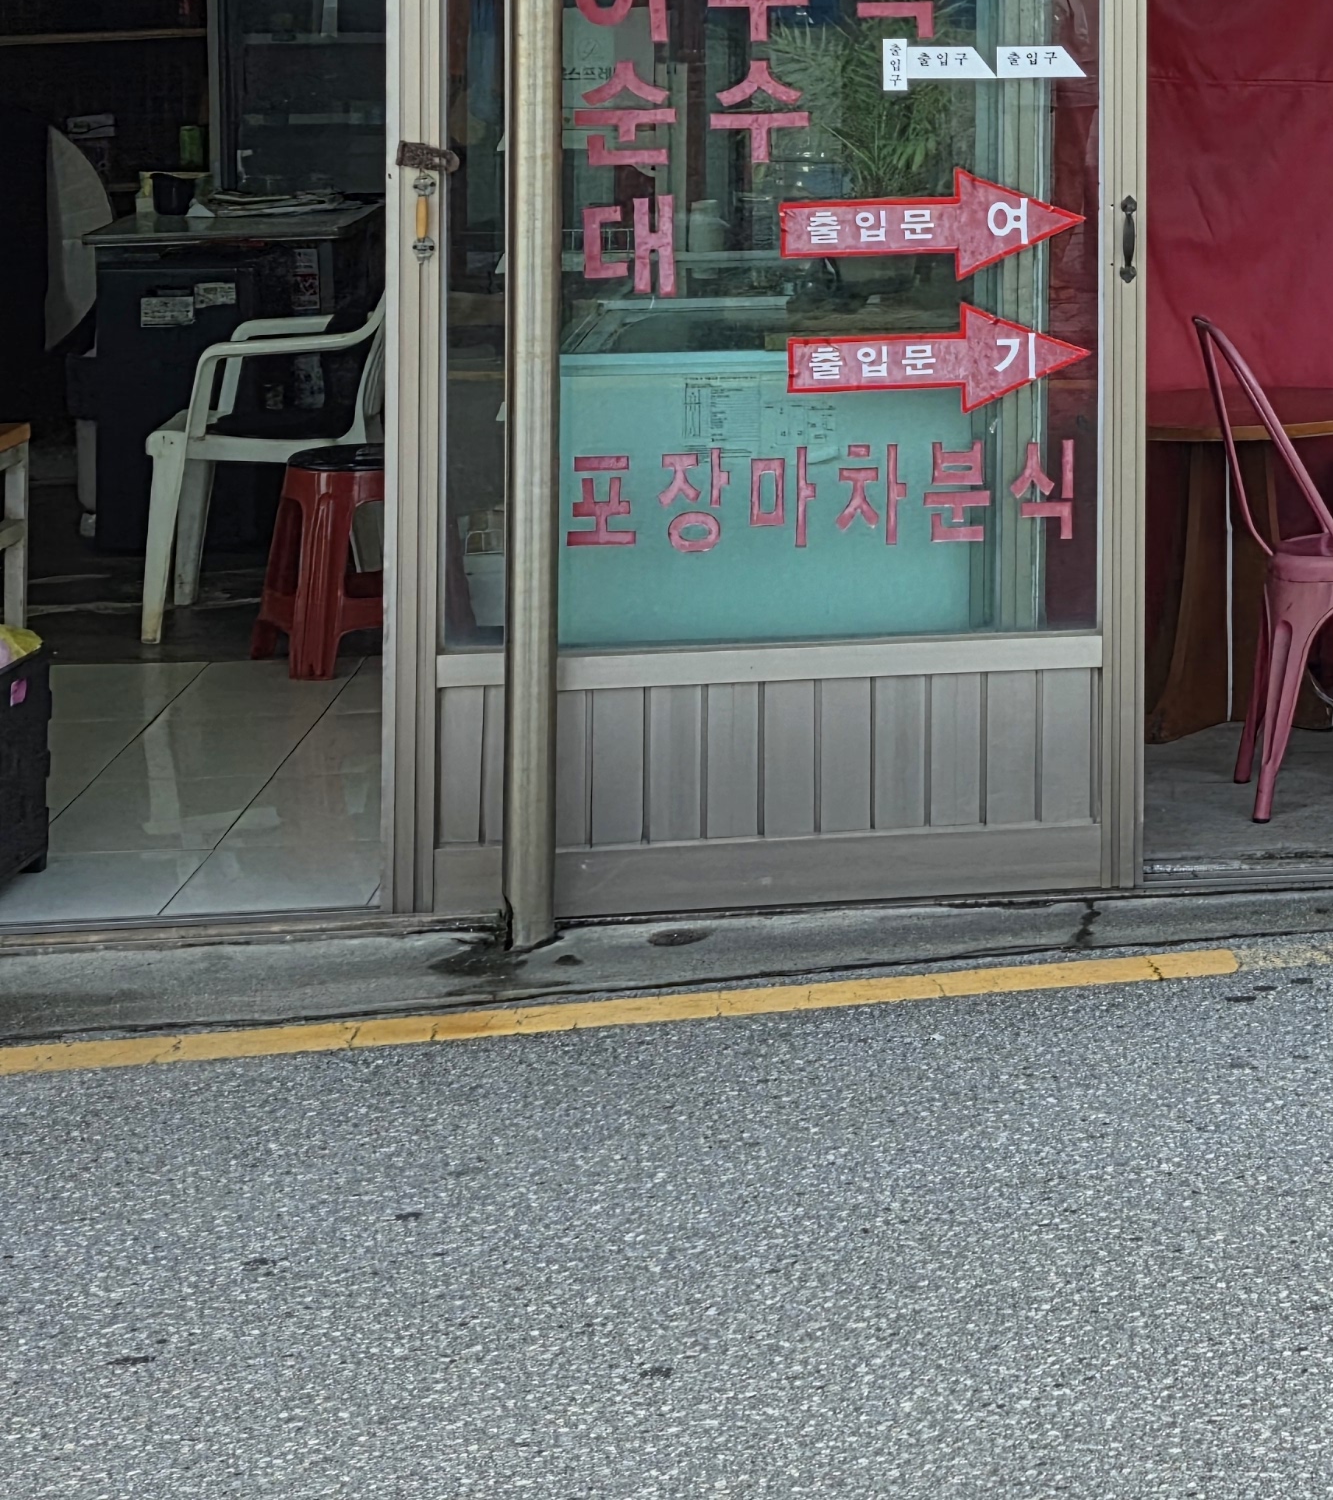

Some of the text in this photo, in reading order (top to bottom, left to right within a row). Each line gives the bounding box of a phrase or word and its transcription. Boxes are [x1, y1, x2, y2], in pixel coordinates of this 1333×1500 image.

[917, 52, 968, 67] 출입구
[1007, 51, 1058, 66] 출입구
[806, 198, 1029, 245] 출입문 여
[808, 332, 1037, 381] 출입문 기
